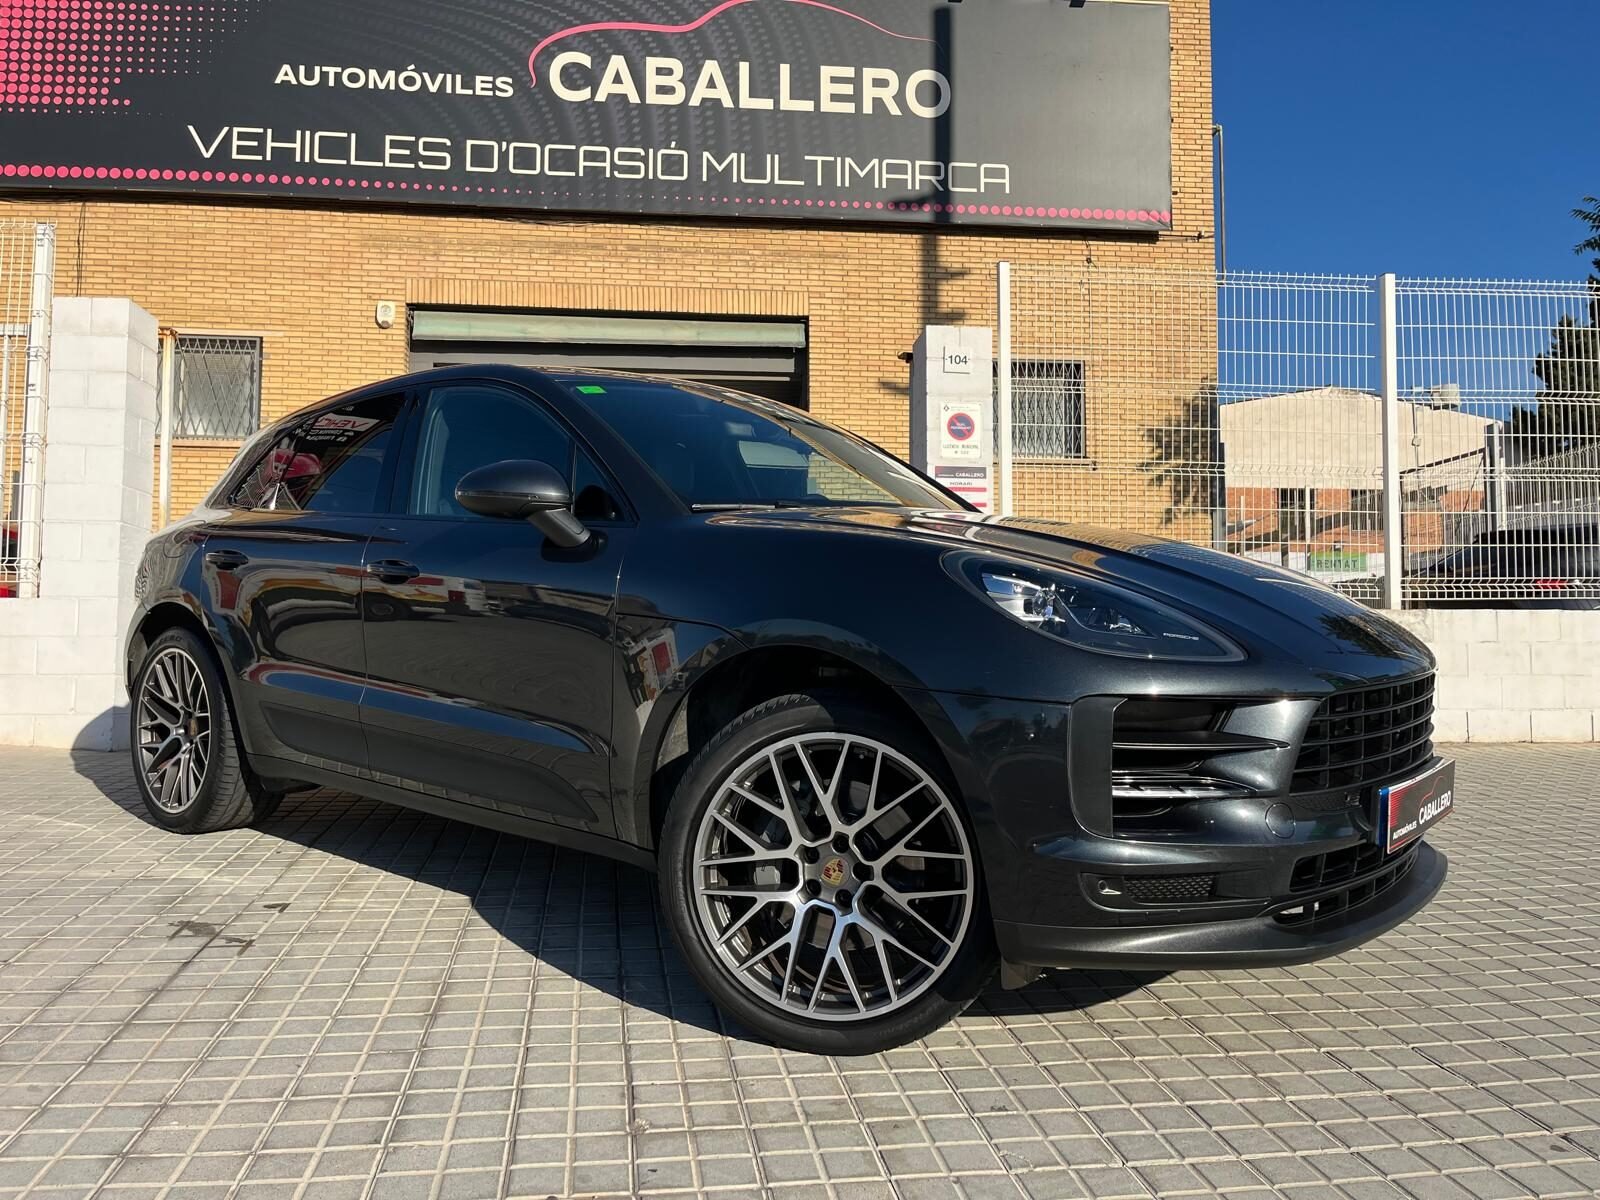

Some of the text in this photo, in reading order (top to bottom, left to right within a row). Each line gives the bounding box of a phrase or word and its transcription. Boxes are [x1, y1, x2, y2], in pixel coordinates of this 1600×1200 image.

[274, 51, 951, 118] AUTOMÓVILES CABALLERO
[187, 124, 1010, 194] VEHICLES D'OCASIÓ MULTIMARCA
[948, 354, 968, 365] 104
[1419, 790, 1451, 824] CABALLERO
